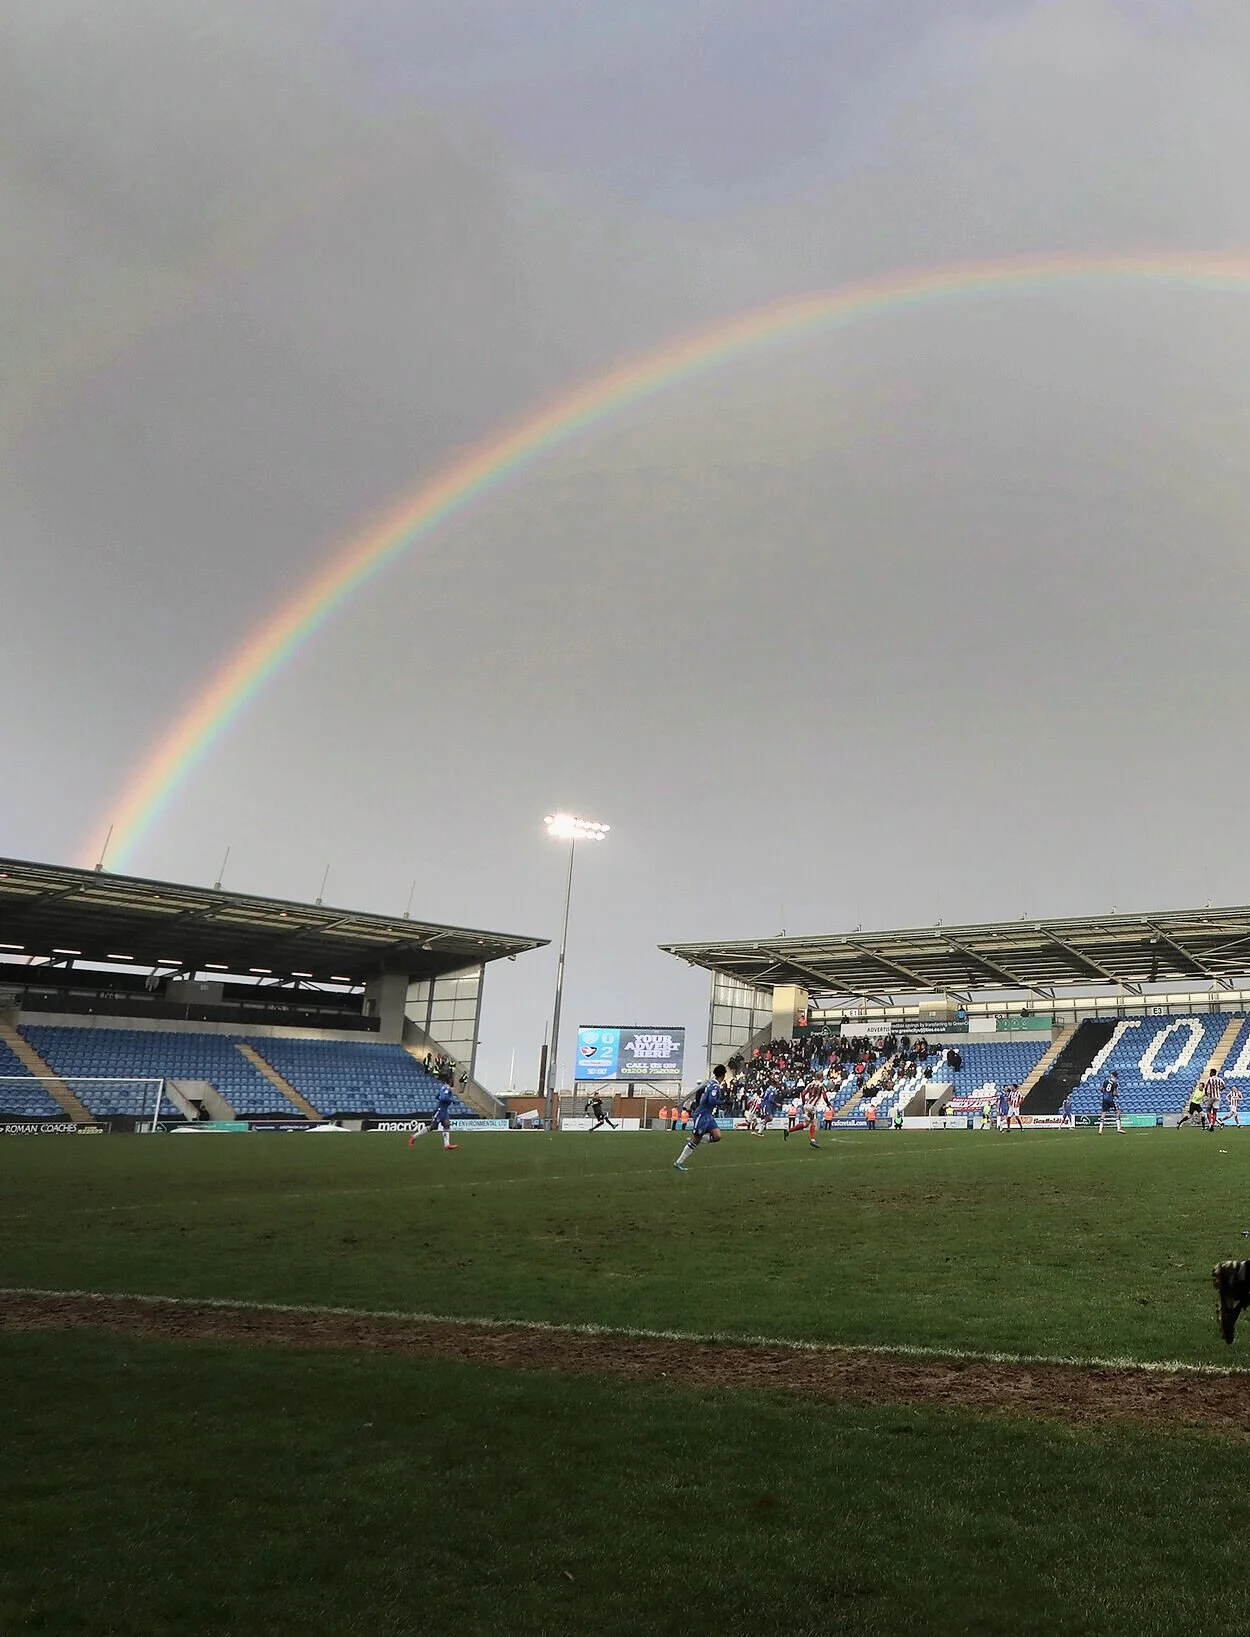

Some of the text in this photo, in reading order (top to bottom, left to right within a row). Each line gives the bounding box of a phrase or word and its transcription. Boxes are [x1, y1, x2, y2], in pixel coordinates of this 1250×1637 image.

[1153, 1007, 1162, 1015] E3
[601, 1033, 614, 1044] 0
[633, 1034, 672, 1043] YOUR
[624, 1042, 680, 1051] ADVERT
[600, 1046, 614, 1058] 2
[633, 1050, 671, 1058] HERE
[378, 1119, 426, 1132] macron
[458, 1119, 498, 1127] ENVIRONMENTAL
[1033, 1117, 1069, 1125] Scaffoldig
[5, 1123, 78, 1133] ROMAN COACHES
